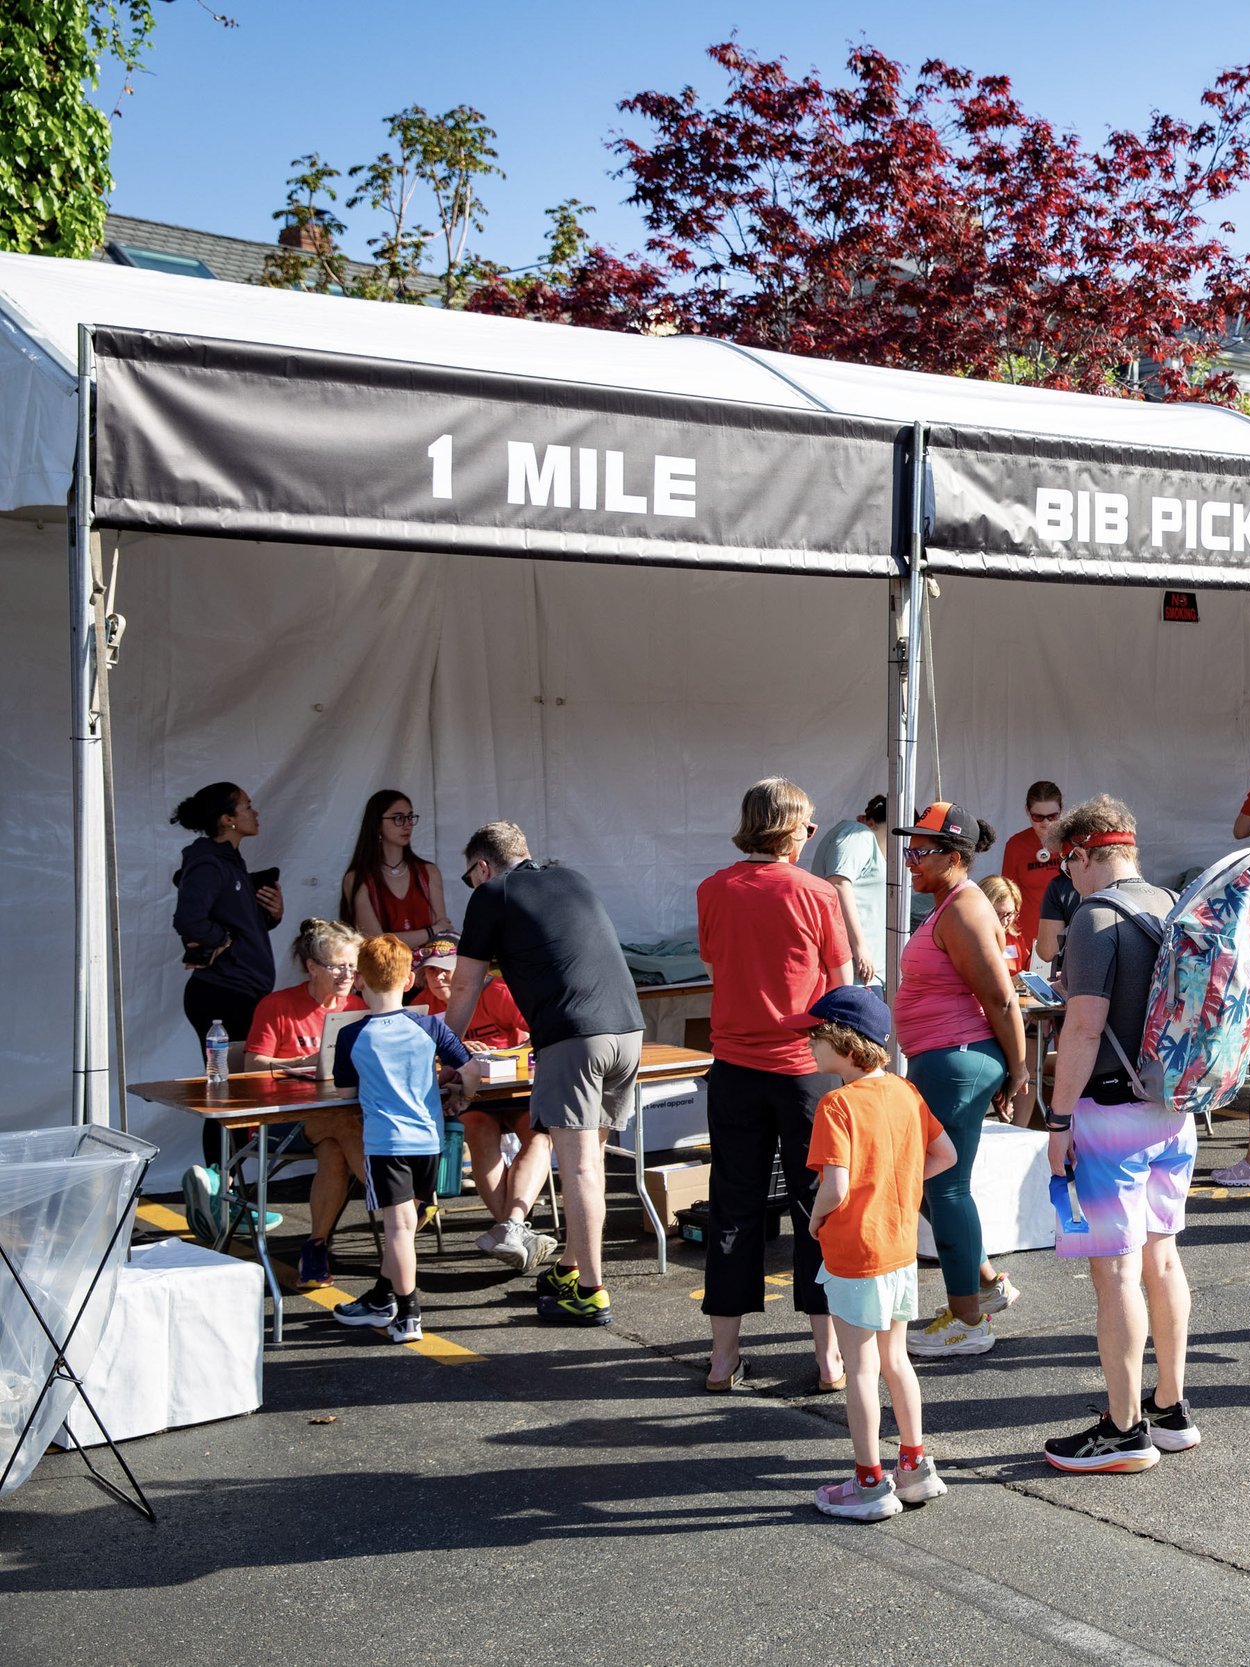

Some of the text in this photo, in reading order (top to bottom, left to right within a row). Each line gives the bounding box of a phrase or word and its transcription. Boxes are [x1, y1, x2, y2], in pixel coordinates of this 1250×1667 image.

[428, 434, 696, 517] 1 MILE
[1036, 487, 1128, 545] BIB
[1171, 593, 1188, 606] NO
[1165, 607, 1197, 620] SMOKING
[650, 1101, 667, 1109] level
[667, 1097, 695, 1108] apparel
[944, 1333, 967, 1345] HOKA
